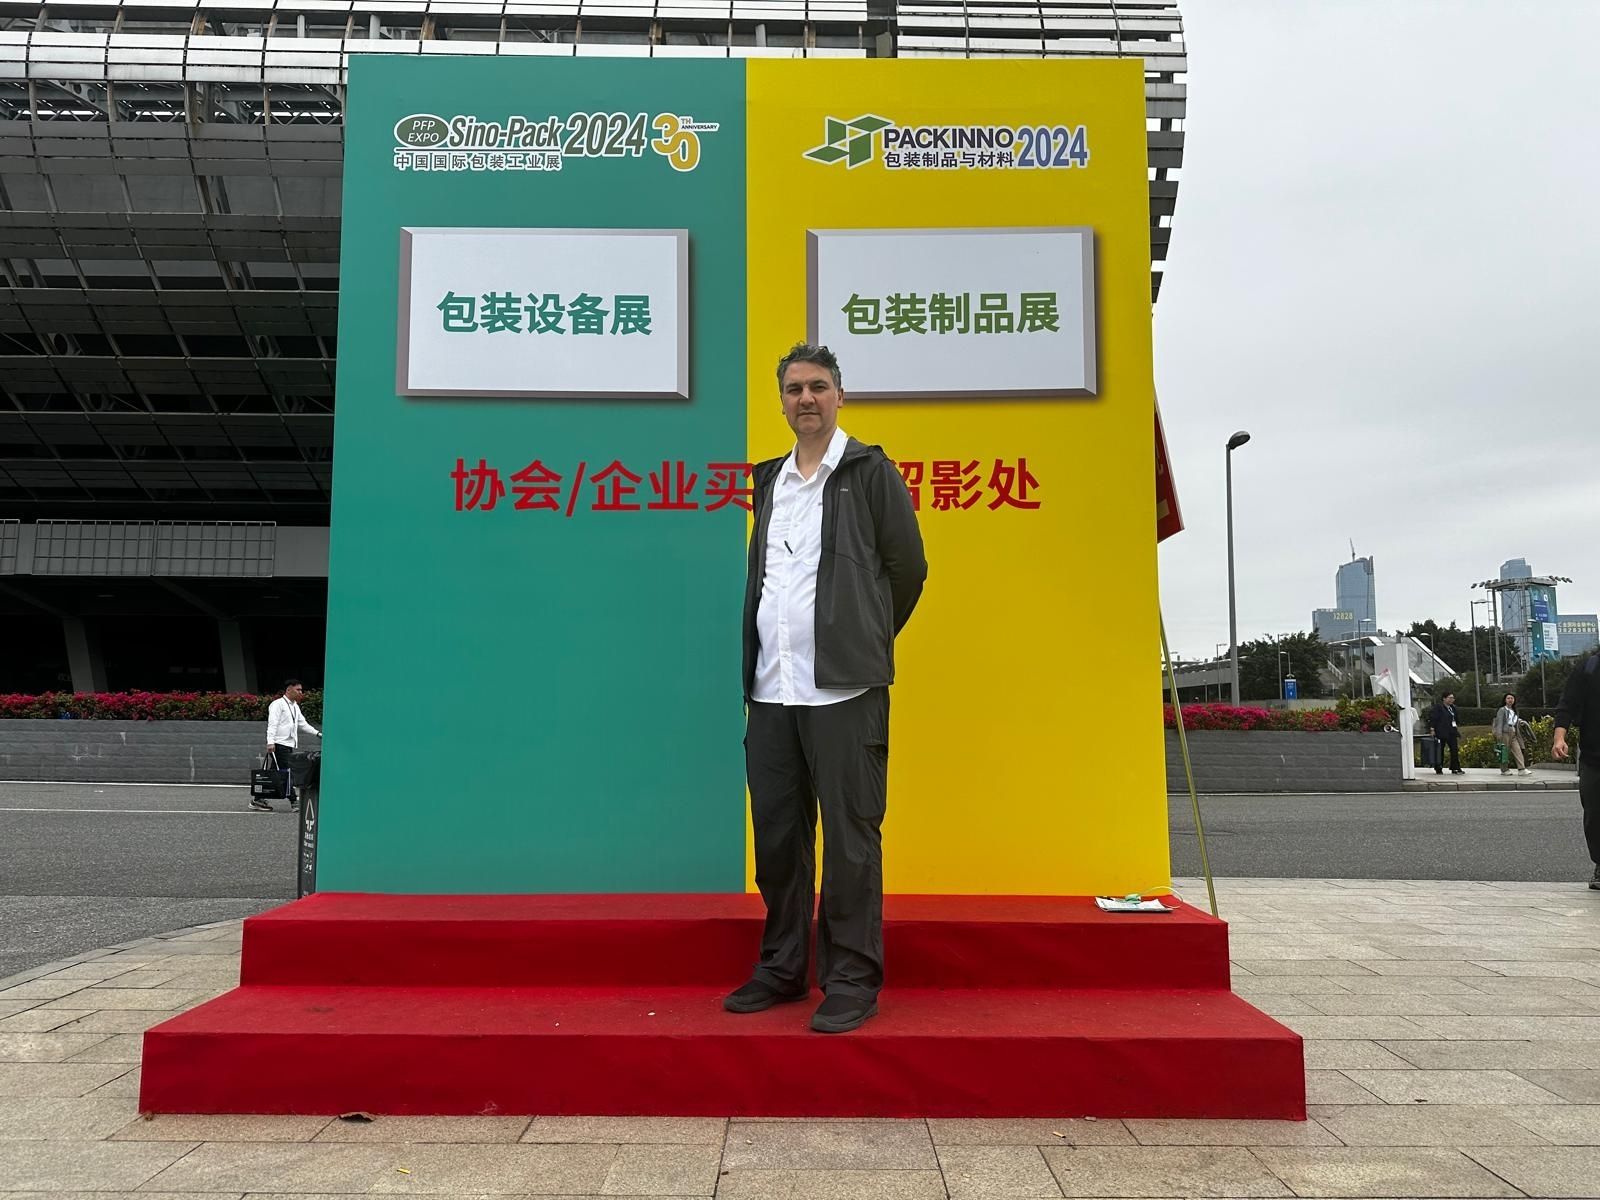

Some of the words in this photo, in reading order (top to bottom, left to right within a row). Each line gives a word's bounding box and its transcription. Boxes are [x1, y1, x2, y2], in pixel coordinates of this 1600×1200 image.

[407, 132, 440, 143] EXPO
[412, 120, 436, 131] PFP
[449, 116, 563, 147] Sino-Pack
[564, 114, 646, 155] 2024
[395, 153, 562, 169] 中国国际包装工业展
[884, 127, 1014, 149] PACKINNO
[1017, 127, 1088, 167] 2024
[884, 151, 1015, 168] 包装制品与材料
[436, 291, 653, 336] 包装设备展
[841, 292, 1061, 336] 包装制品展
